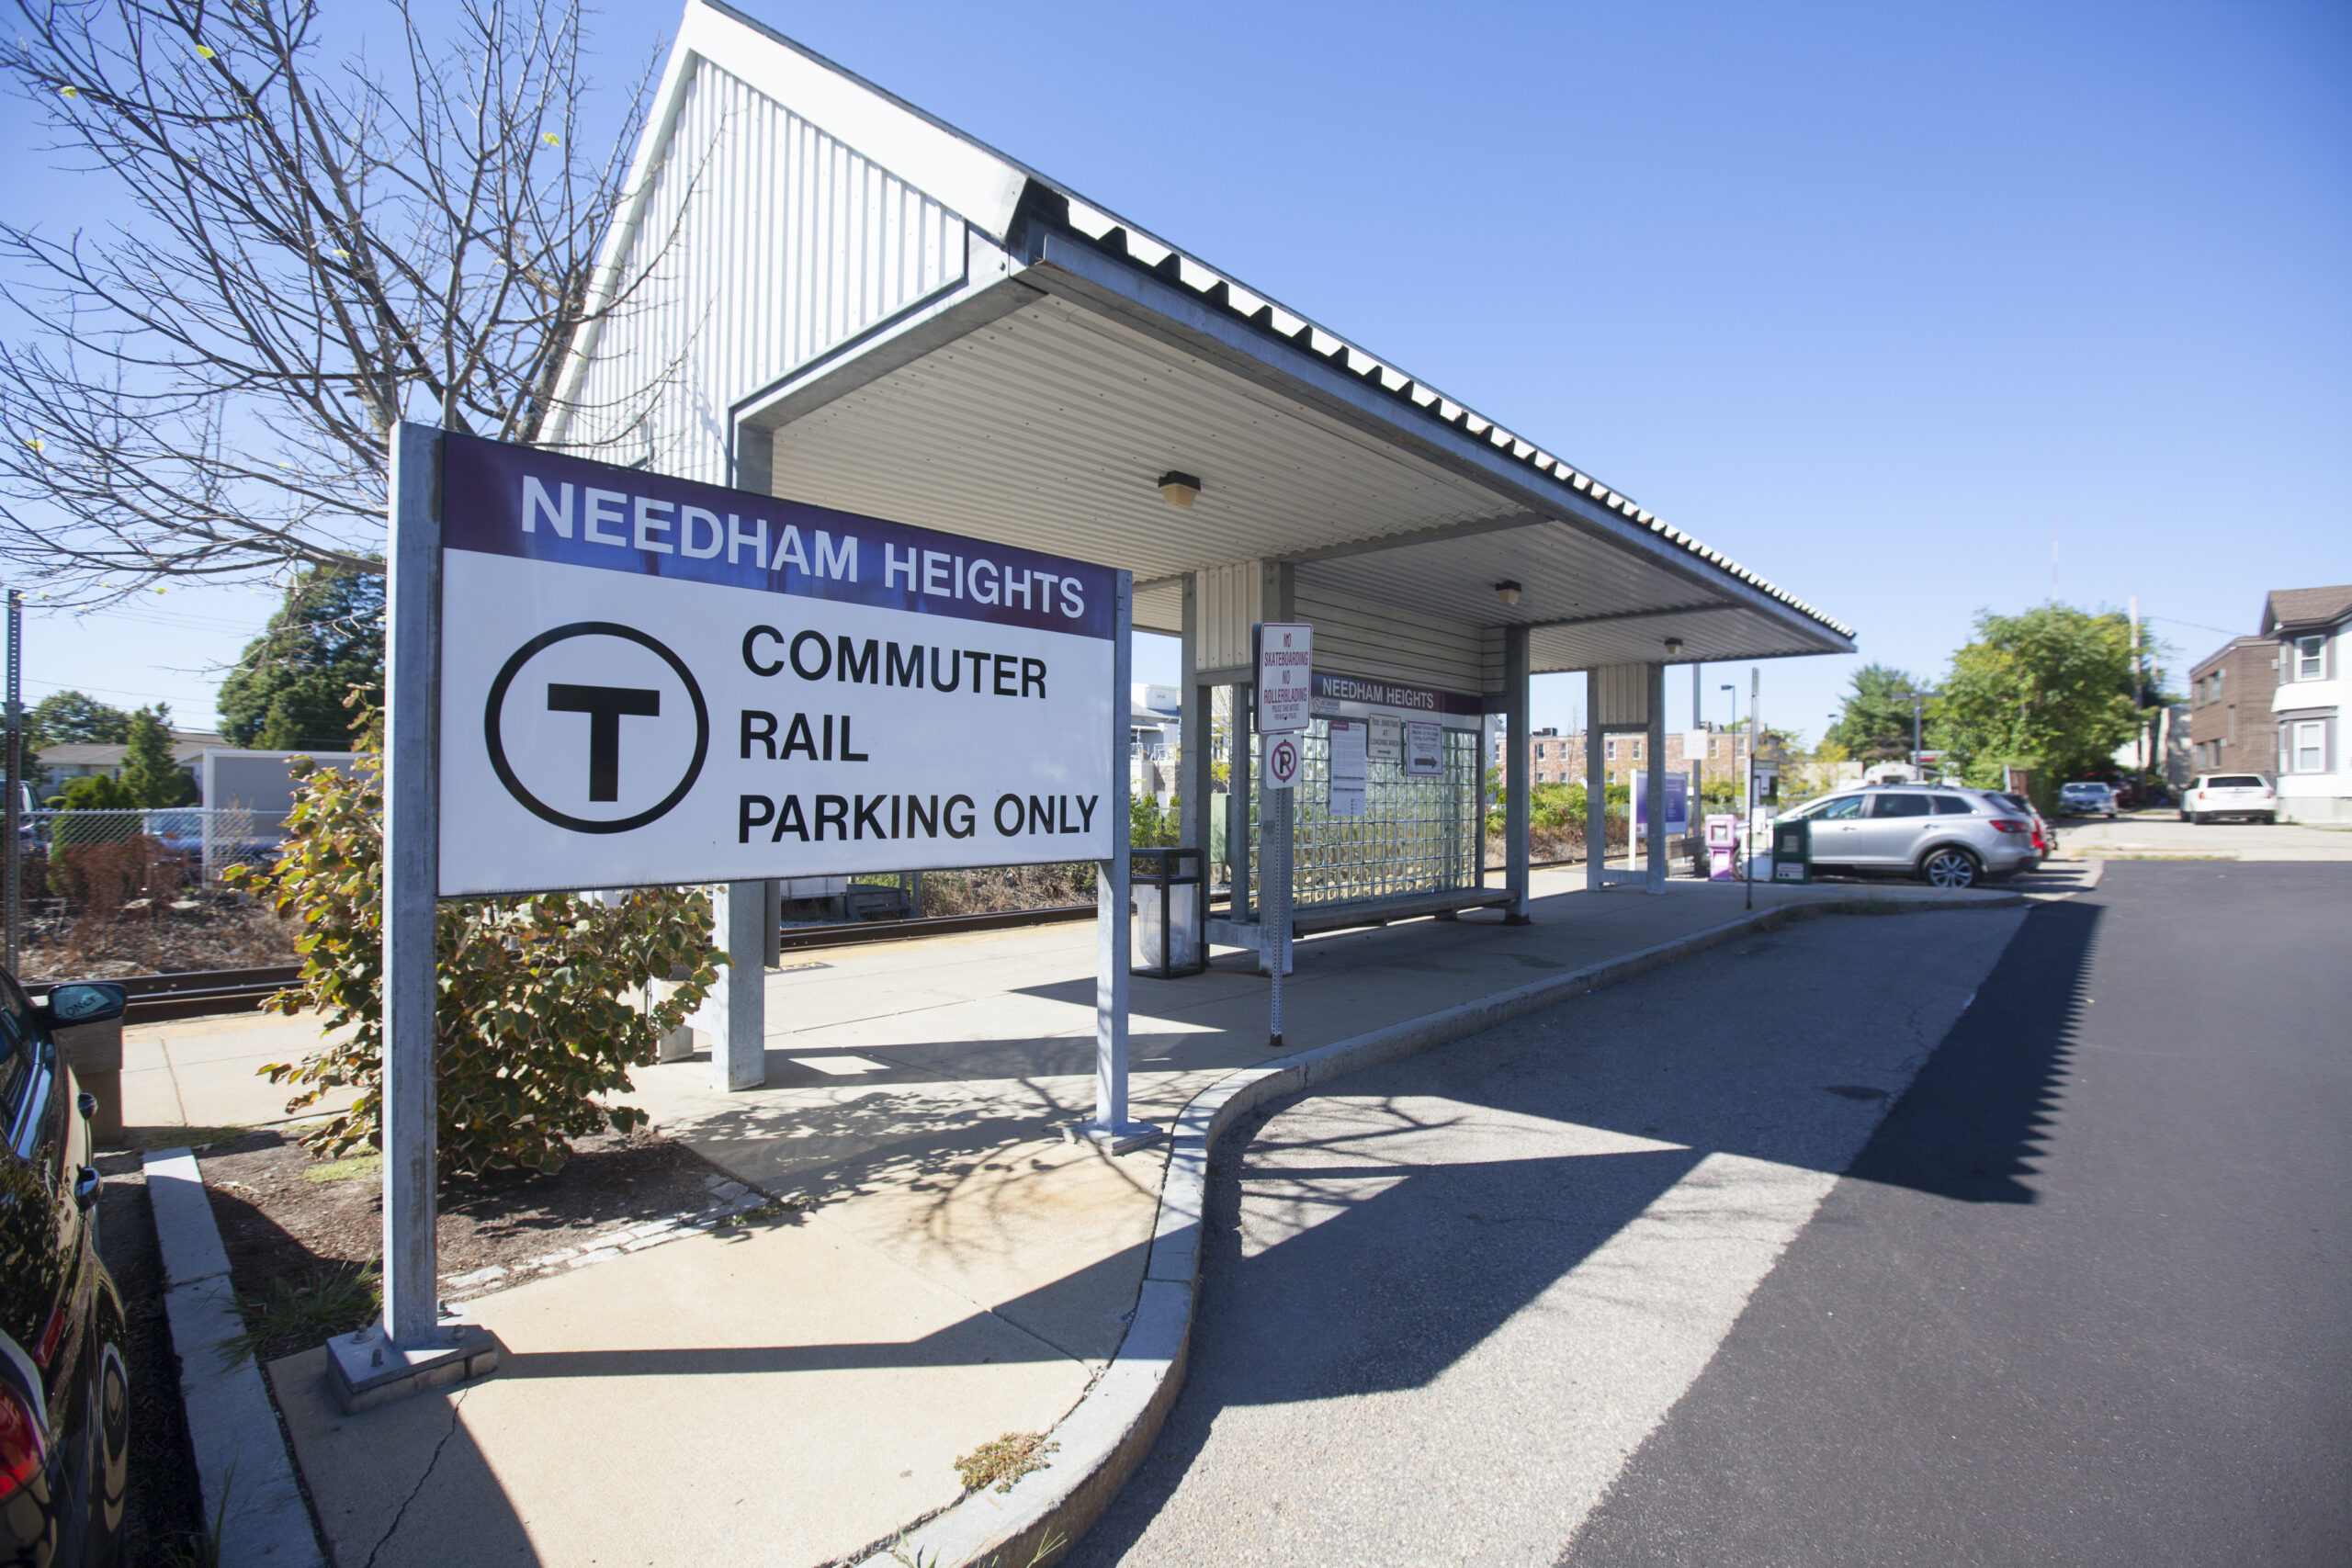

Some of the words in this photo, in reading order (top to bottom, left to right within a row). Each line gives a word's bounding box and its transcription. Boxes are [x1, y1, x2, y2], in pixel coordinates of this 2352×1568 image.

[521, 475, 859, 583] NEEDHAM
[885, 542, 1085, 619] HEIGHTS
[1264, 651, 1308, 667] SKATEBOARDING
[1283, 632, 1292, 648] NO
[742, 625, 1046, 699] COMMUTER
[1283, 670, 1291, 685] NO
[1263, 687, 1307, 704] ROLLERBLADING
[1323, 678, 1383, 703] NEEDHAM
[1386, 687, 1434, 709] HEIGHTS
[547, 683, 660, 803] T
[741, 710, 868, 763] RAIL
[739, 794, 976, 843] PARKING
[994, 793, 1099, 837] ONLY
